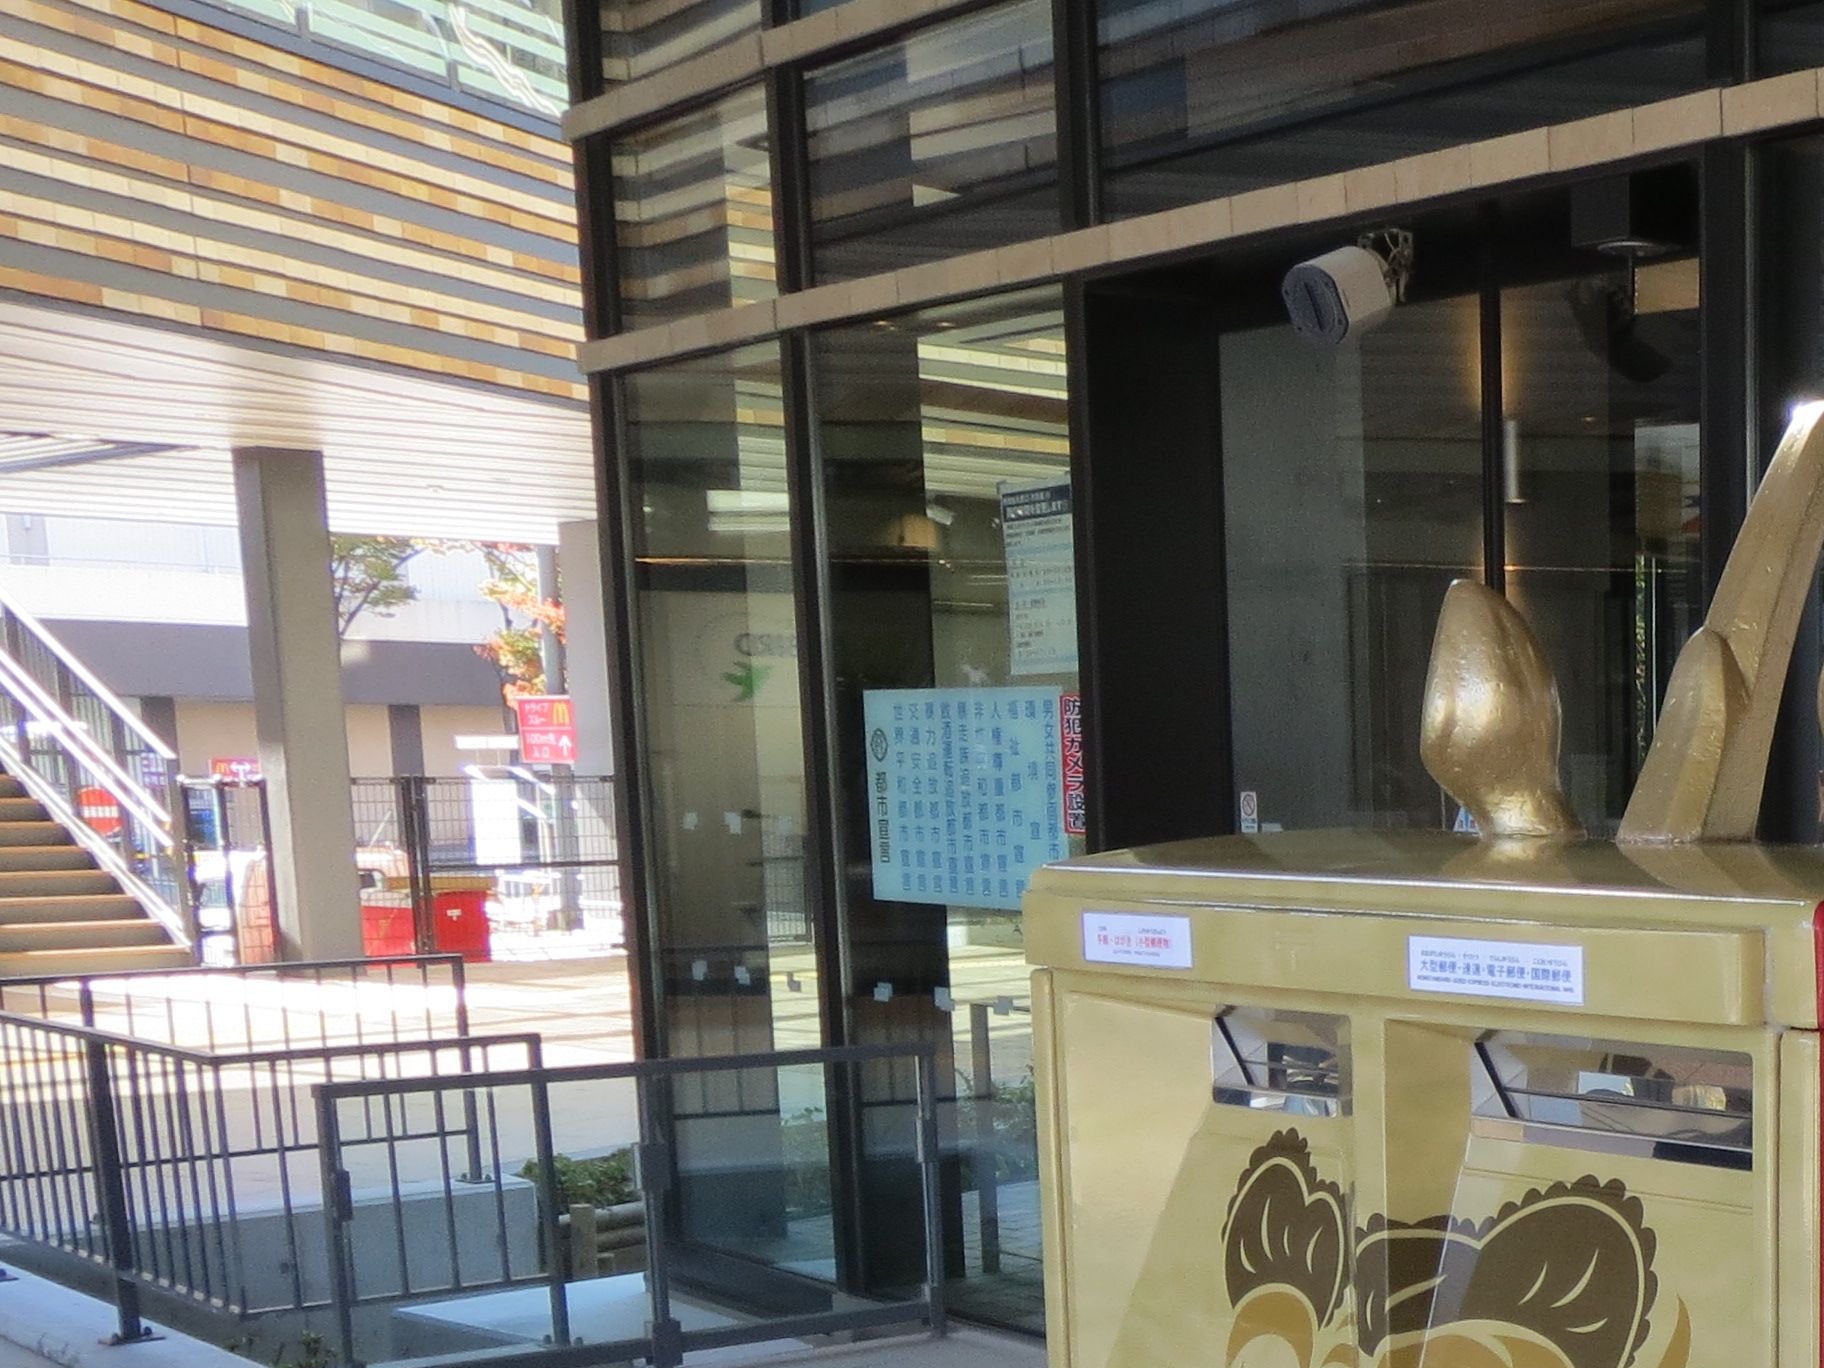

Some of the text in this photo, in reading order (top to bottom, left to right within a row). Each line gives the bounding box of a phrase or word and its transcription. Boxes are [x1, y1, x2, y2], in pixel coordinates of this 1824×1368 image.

[875, 771, 890, 863] 都市宣言
[1063, 696, 1086, 831] 防犯カメラ設置
